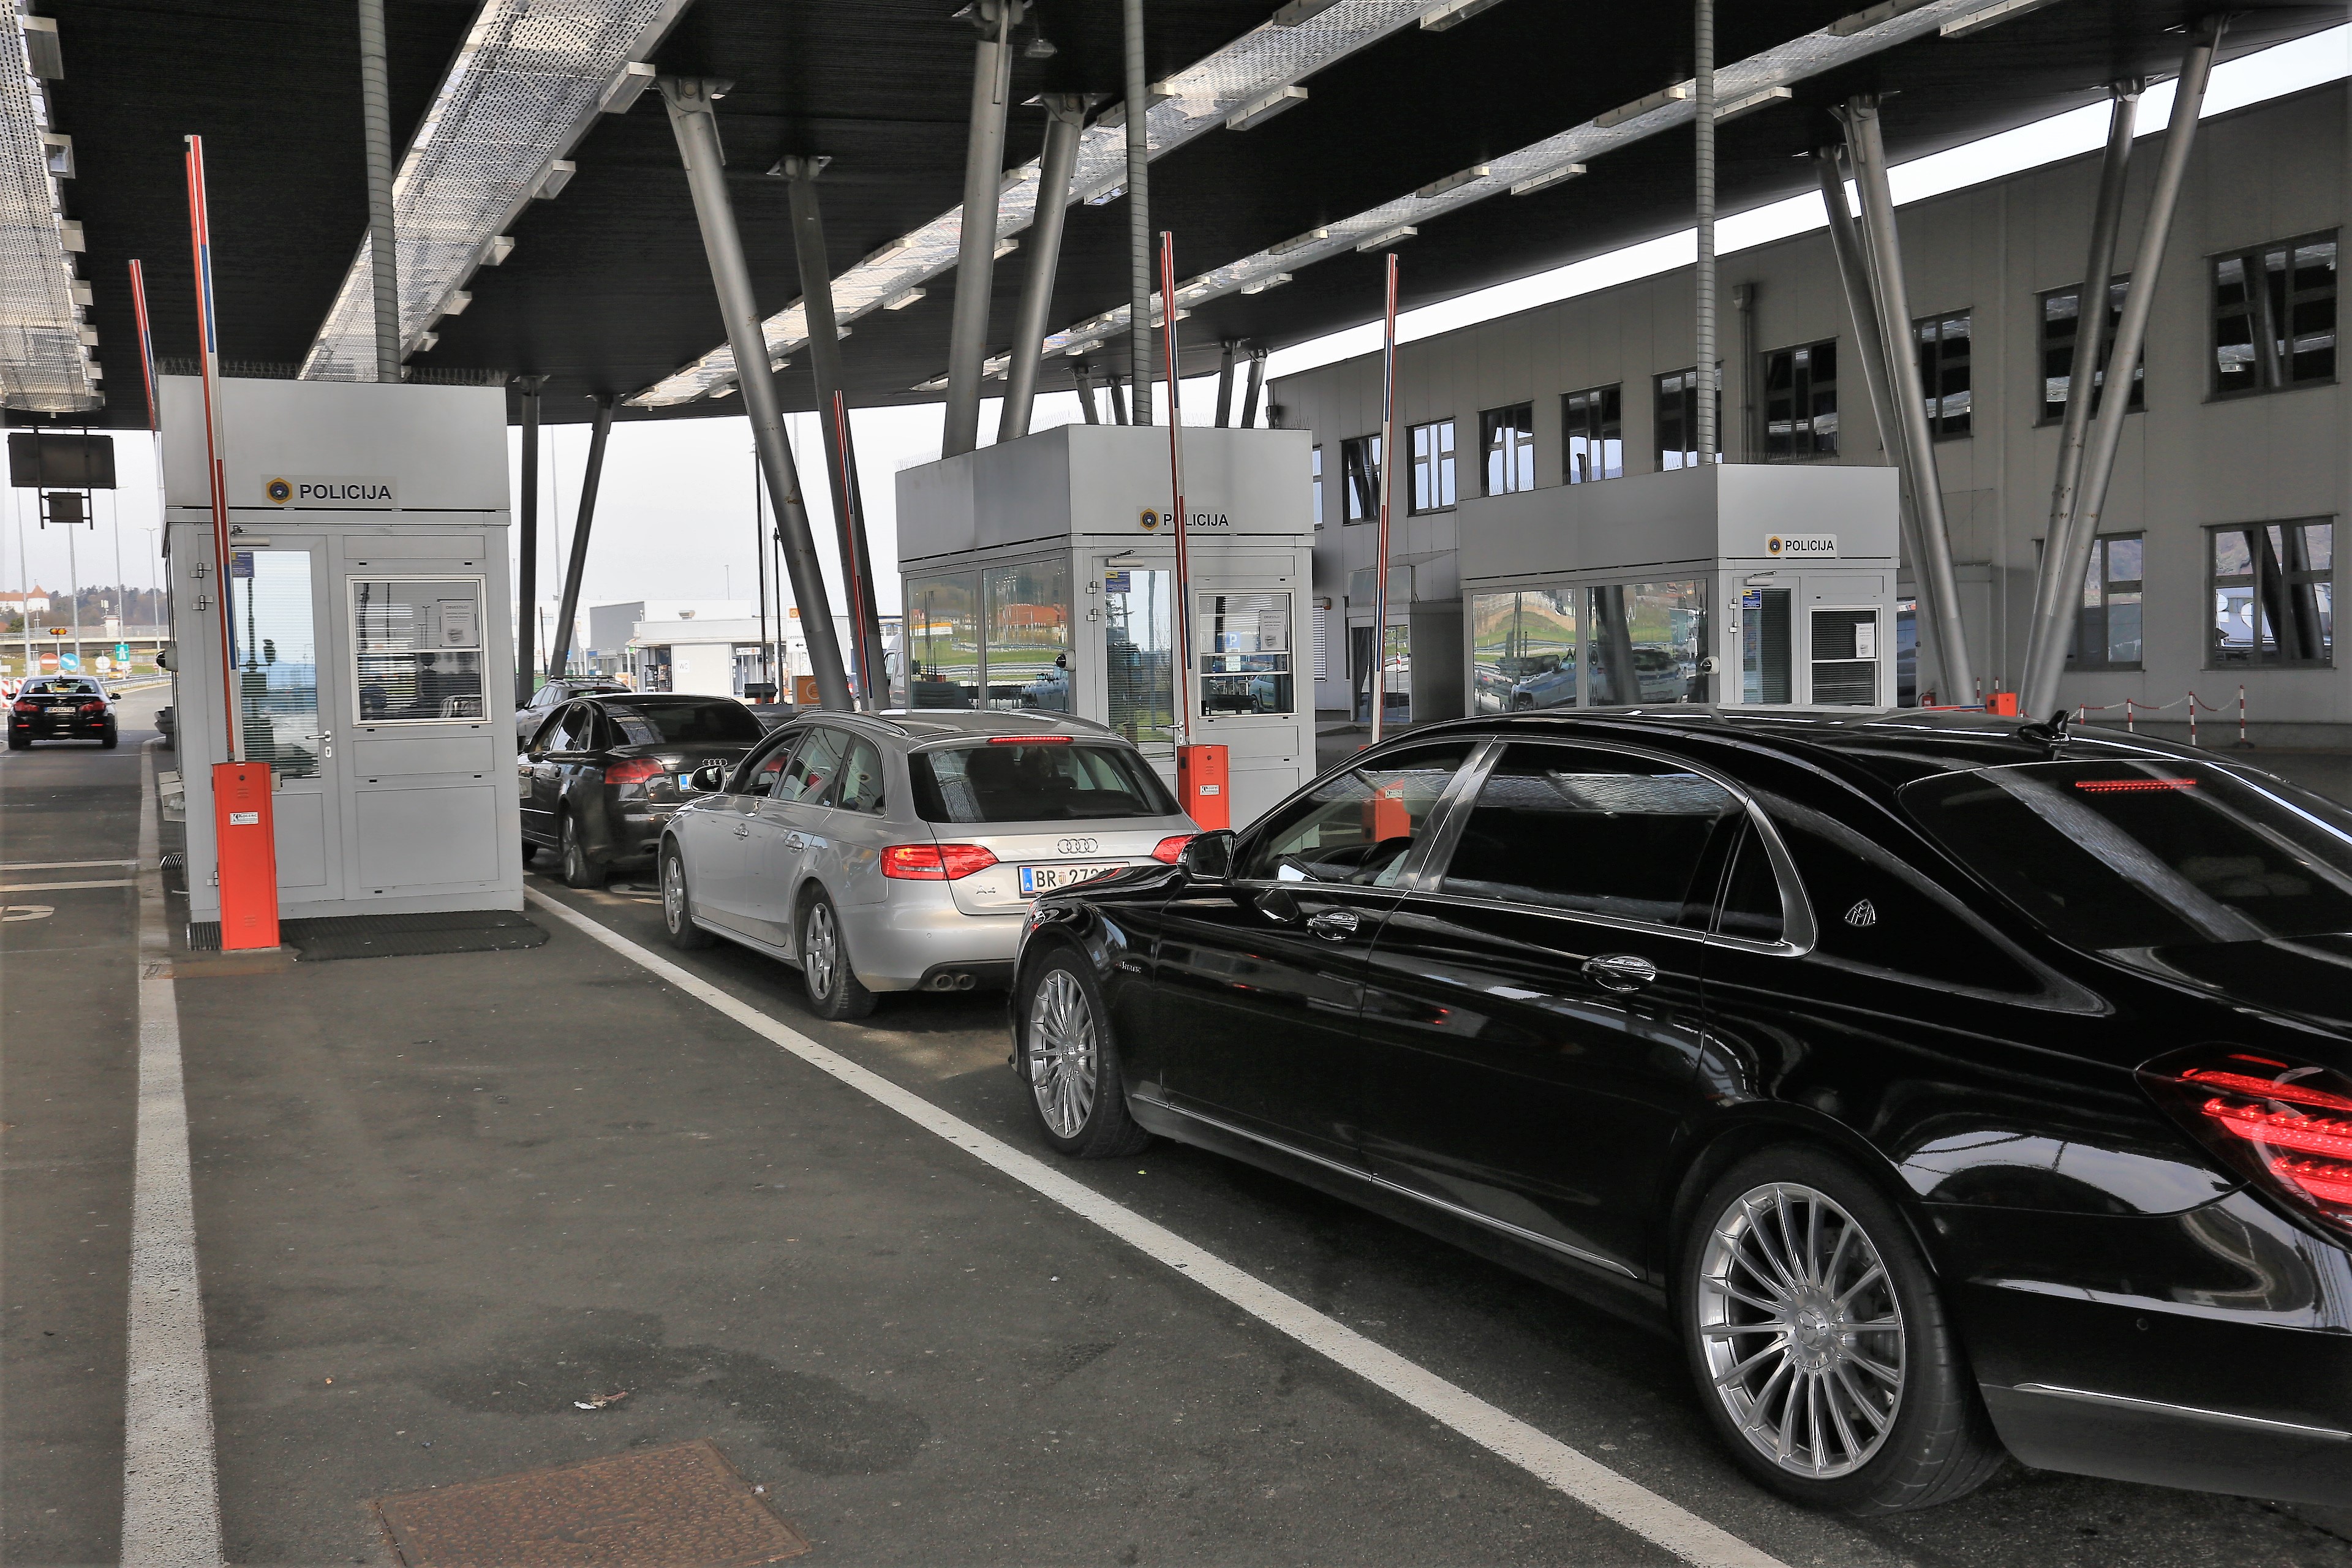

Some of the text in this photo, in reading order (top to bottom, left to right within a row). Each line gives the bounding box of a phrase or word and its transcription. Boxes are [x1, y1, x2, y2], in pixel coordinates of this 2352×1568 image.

[300, 484, 392, 500] POLICIJA
[1163, 513, 1229, 527] PLICIJA
[1785, 540, 1834, 551] POLICIJA
[1036, 868, 1099, 888] BR 27
[976, 884, 997, 895] A4
